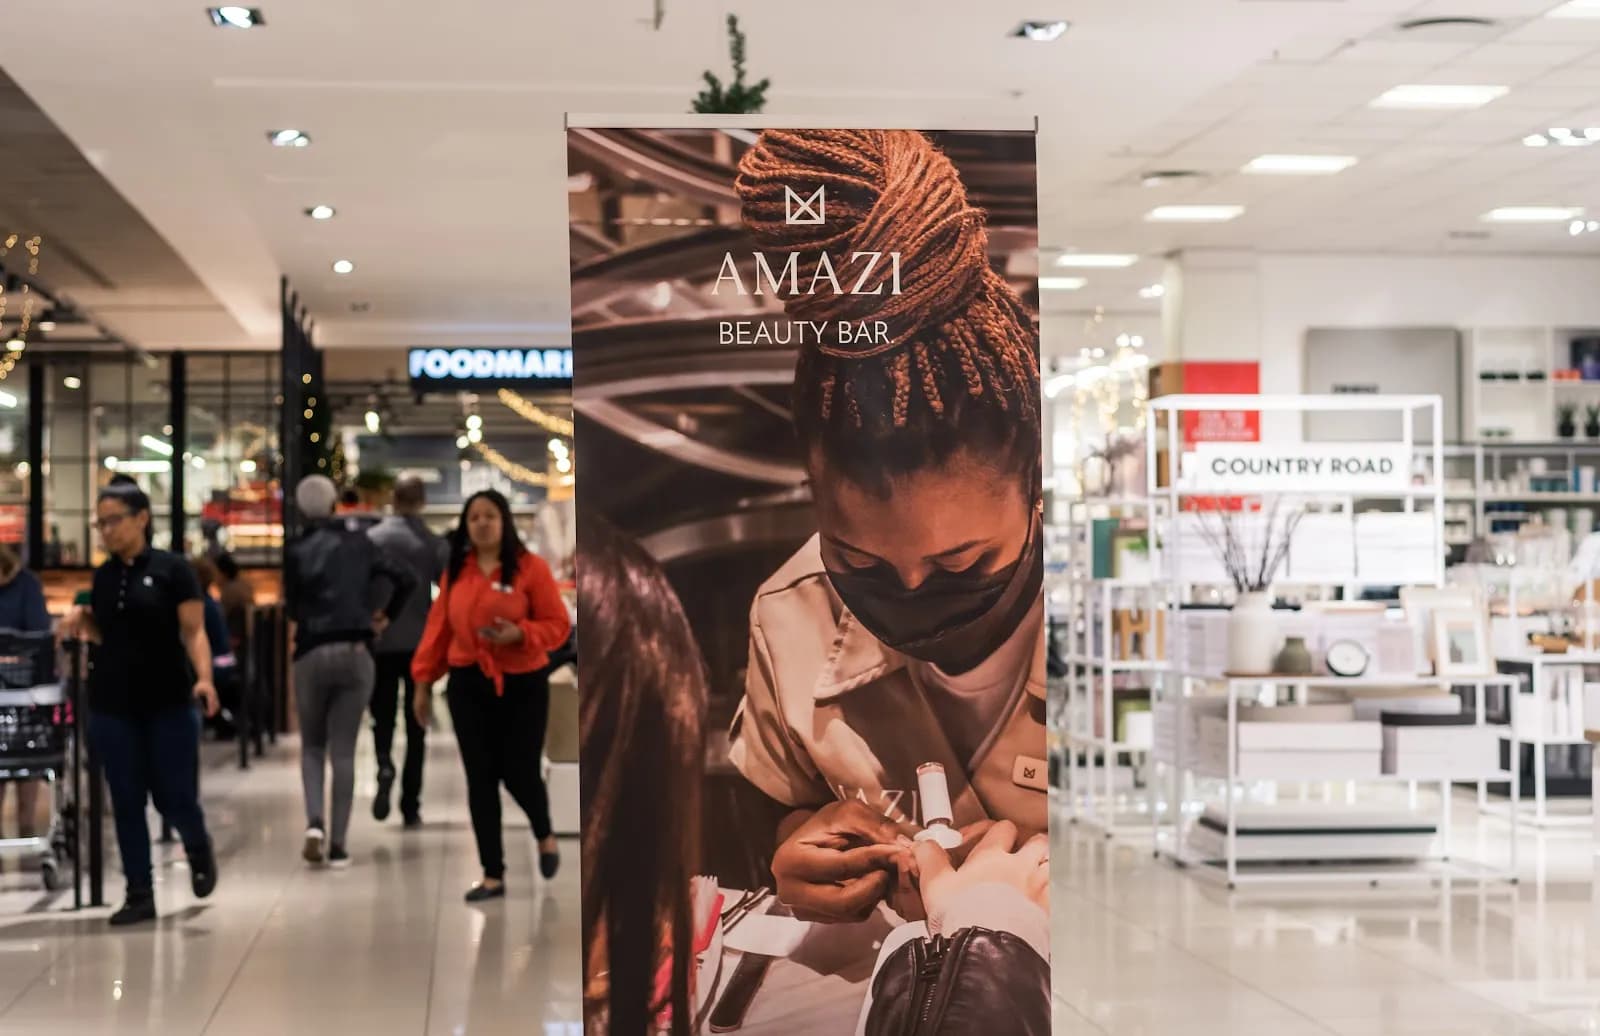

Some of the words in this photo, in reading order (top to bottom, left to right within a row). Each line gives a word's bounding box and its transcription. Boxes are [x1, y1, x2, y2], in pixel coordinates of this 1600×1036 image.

[712, 251, 902, 295] AMAZI
[719, 321, 828, 345] BEAUTY
[1211, 457, 1324, 476] COUNTRY
[1331, 457, 1394, 475] ROAD
